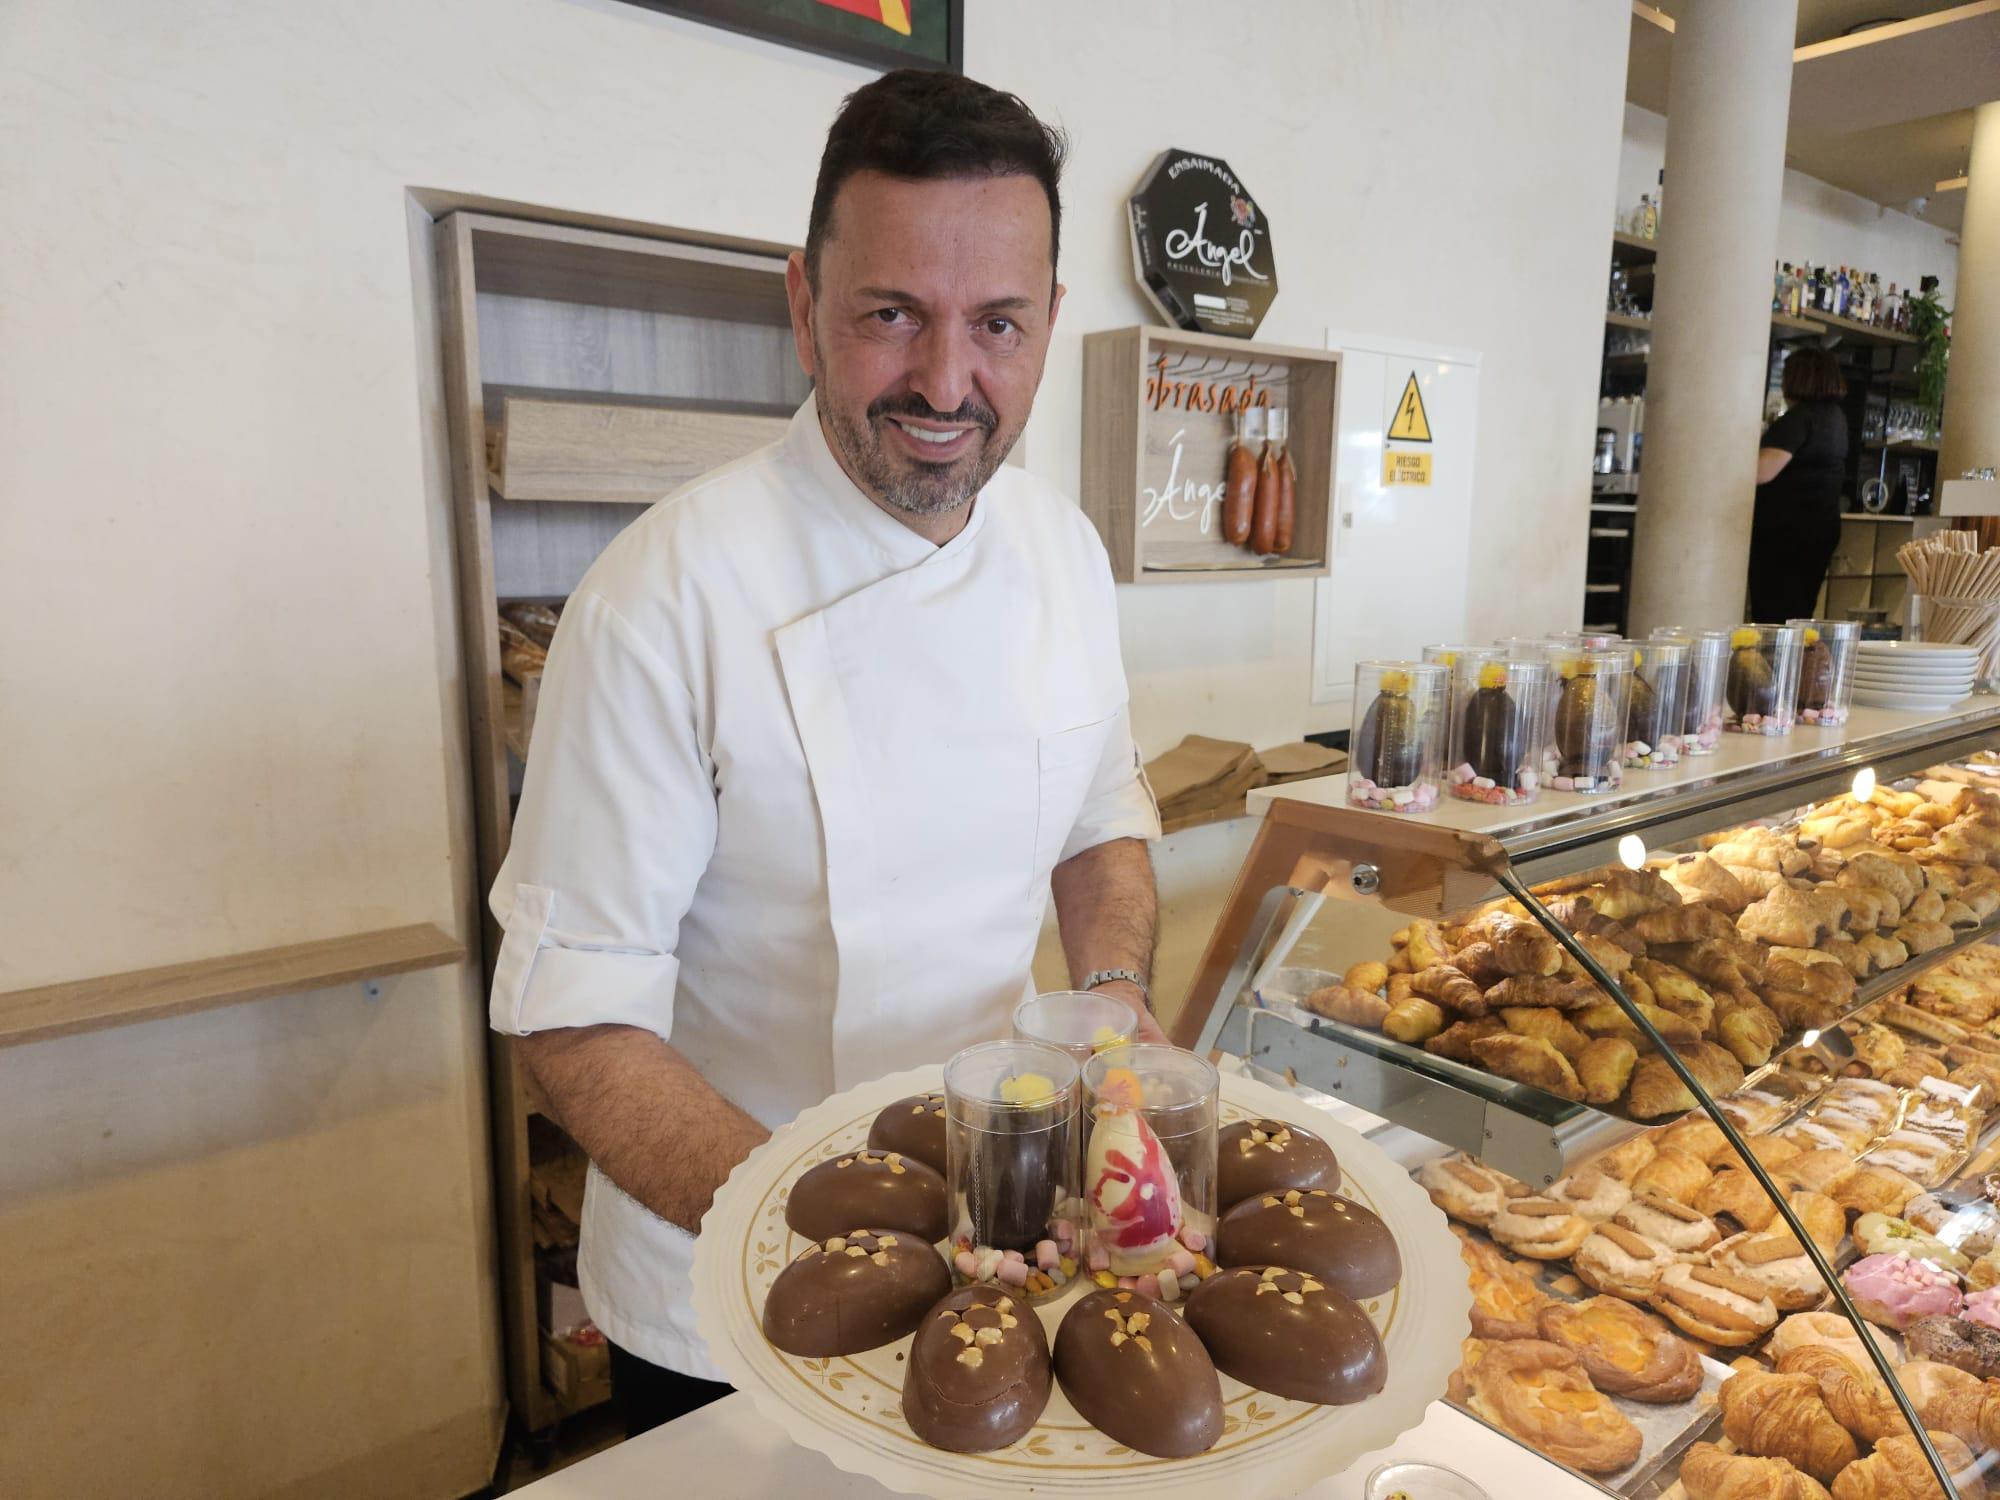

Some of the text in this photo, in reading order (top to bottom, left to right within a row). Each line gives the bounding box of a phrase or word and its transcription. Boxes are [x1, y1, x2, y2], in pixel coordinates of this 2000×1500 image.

[1165, 201, 1268, 287] Ángel
[1147, 355, 1270, 417] obrasada
[1142, 428, 1226, 534] Ánge
[1396, 455, 1421, 467] RIESGO
